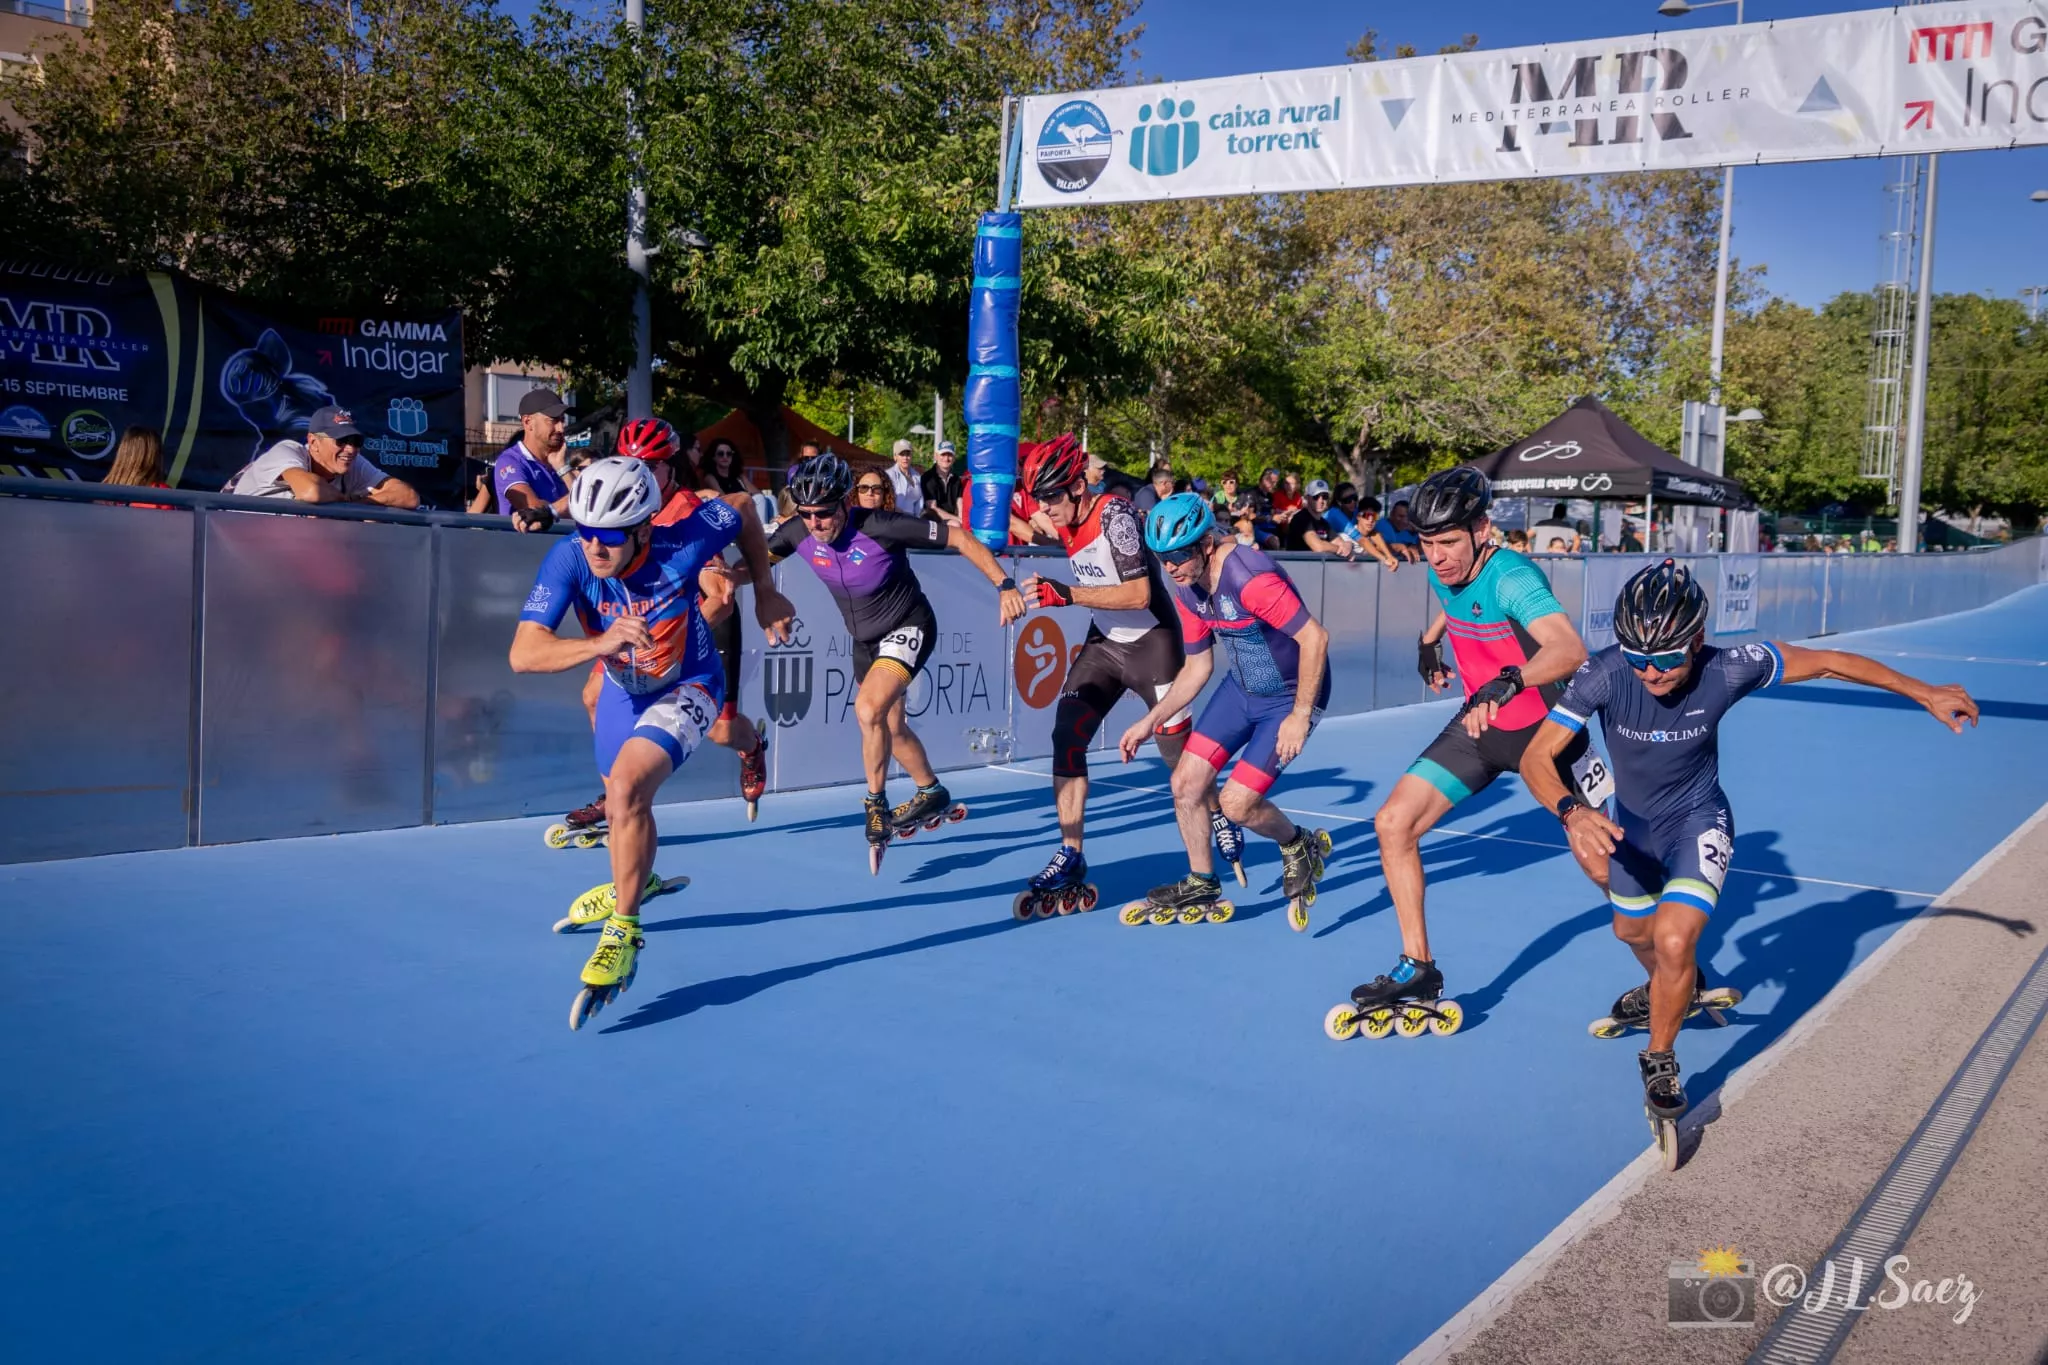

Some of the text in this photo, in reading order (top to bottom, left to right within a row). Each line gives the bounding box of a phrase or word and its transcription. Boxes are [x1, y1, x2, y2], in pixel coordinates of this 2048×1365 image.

[1208, 96, 1341, 130] caixa rural
[1452, 87, 1750, 124] MEDITERRANEA ROLLER
[1226, 127, 1322, 154] torrent
[1040, 149, 1071, 158] PAIPORTA
[1056, 177, 1088, 190] VALENCIA
[360, 319, 447, 342] GAMMA
[89, 339, 149, 352] ROLLER
[343, 338, 449, 379] Indigar
[25, 380, 129, 401] SEPTIEMBRE
[363, 434, 448, 455] caixa rural
[379, 450, 439, 468] torrent
[1546, 475, 1578, 490] equip
[1071, 559, 1106, 577] Arola
[882, 633, 919, 651] 290
[952, 632, 972, 654] DE
